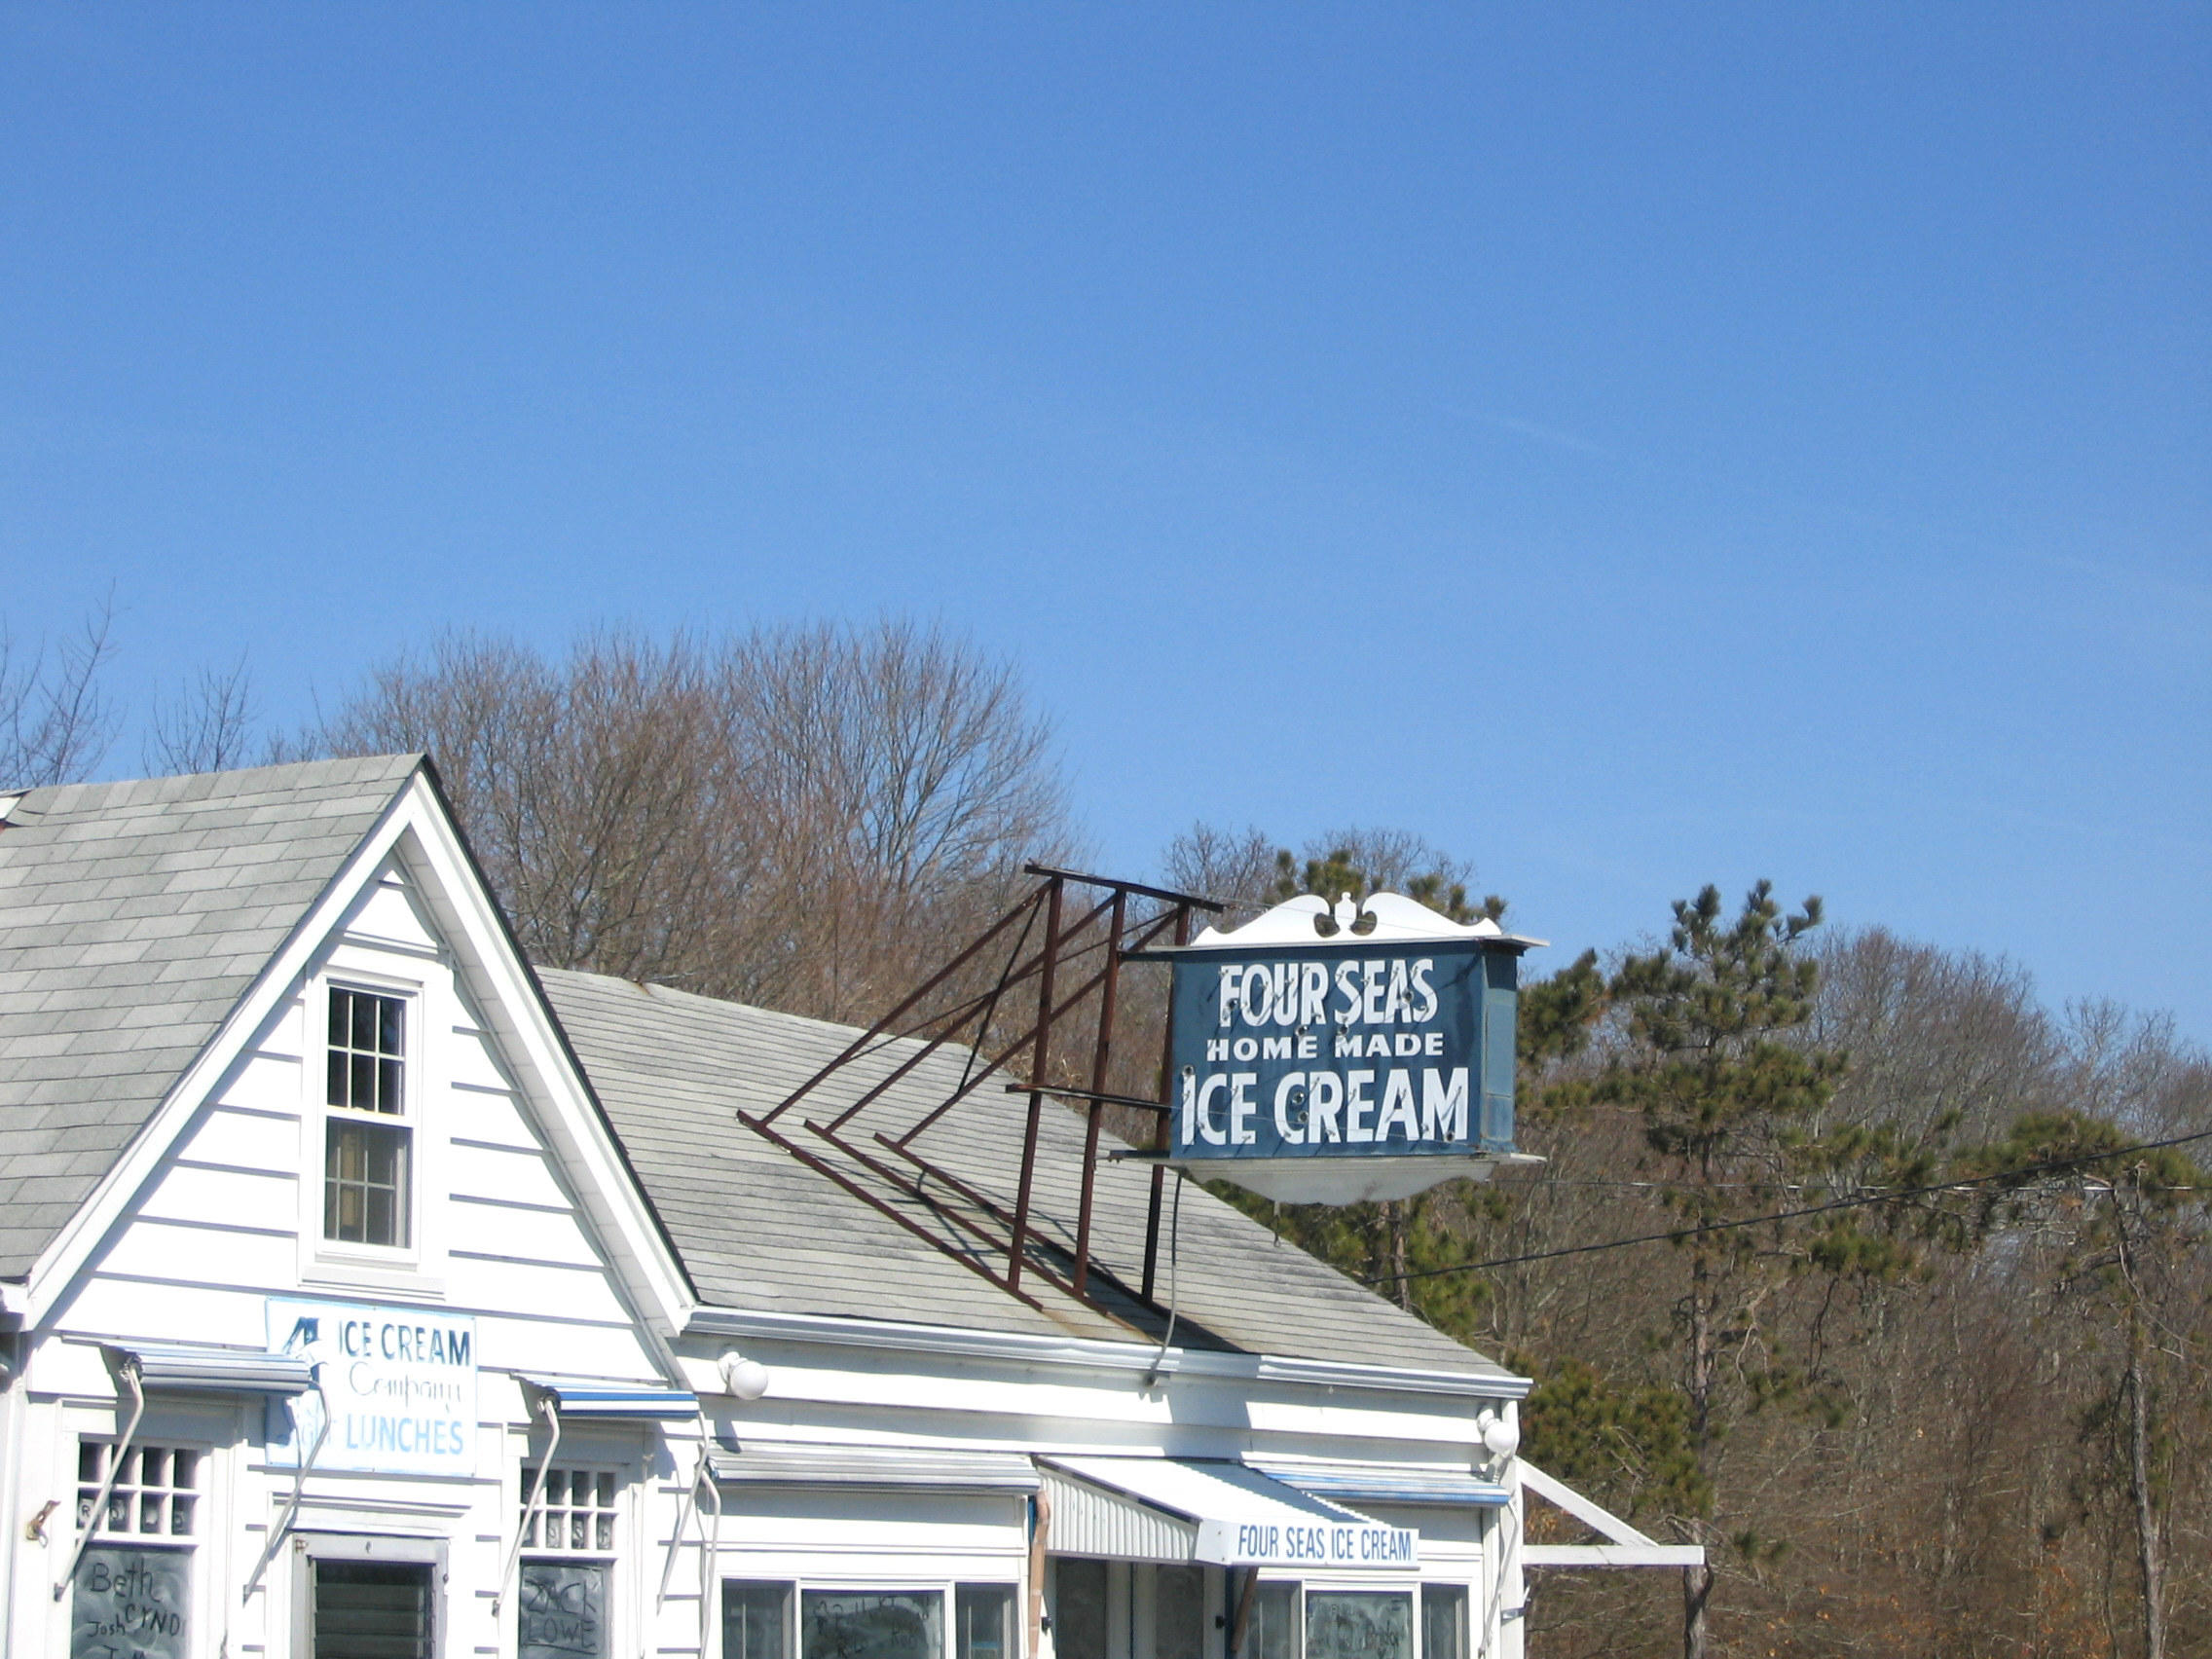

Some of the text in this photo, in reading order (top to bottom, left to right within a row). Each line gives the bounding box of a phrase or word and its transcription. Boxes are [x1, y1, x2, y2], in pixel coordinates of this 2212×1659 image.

[1219, 958, 1438, 1027] FOUR SEAS
[1206, 1032, 1444, 1062] HOME MADE
[1181, 1067, 1469, 1146] ICE CREAM
[339, 1320, 470, 1366] ICE CREAM
[346, 1414, 464, 1456] LUNCHES
[1237, 1525, 1412, 1561] FOUR SEAS ICE CREAM
[90, 1557, 163, 1604] Beth
[87, 1612, 126, 1638] Josh
